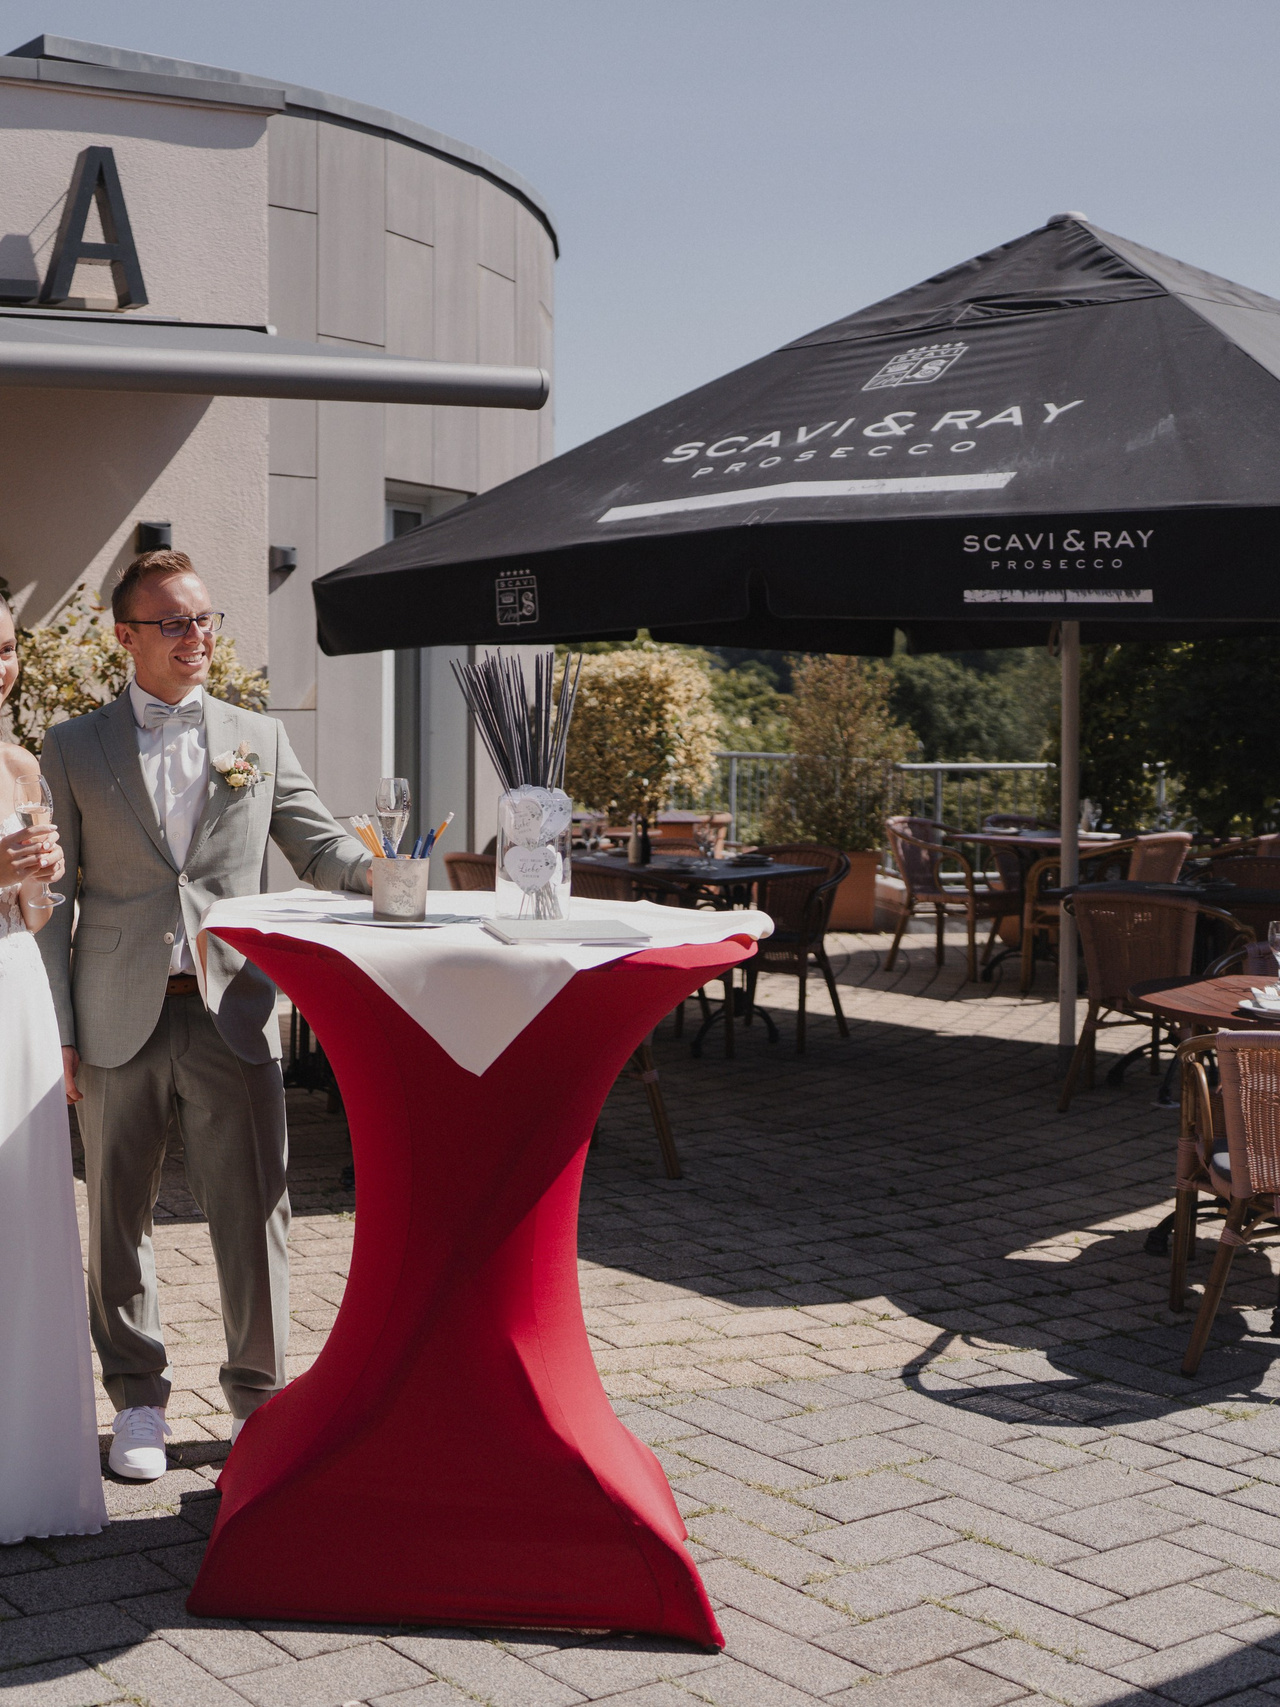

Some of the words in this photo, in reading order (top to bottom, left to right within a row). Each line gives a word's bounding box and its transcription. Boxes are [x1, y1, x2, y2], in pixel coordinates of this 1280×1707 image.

[662, 417, 856, 464] SCAVI
[862, 411, 918, 438] &
[931, 400, 1085, 432] RAY
[691, 440, 977, 479] PROSECCO
[963, 532, 1054, 553] SCAVI
[1062, 529, 1086, 552] &
[1094, 529, 1155, 549] RAY
[991, 558, 1123, 570] PROSECCO
[500, 579, 533, 588] SCAVI
